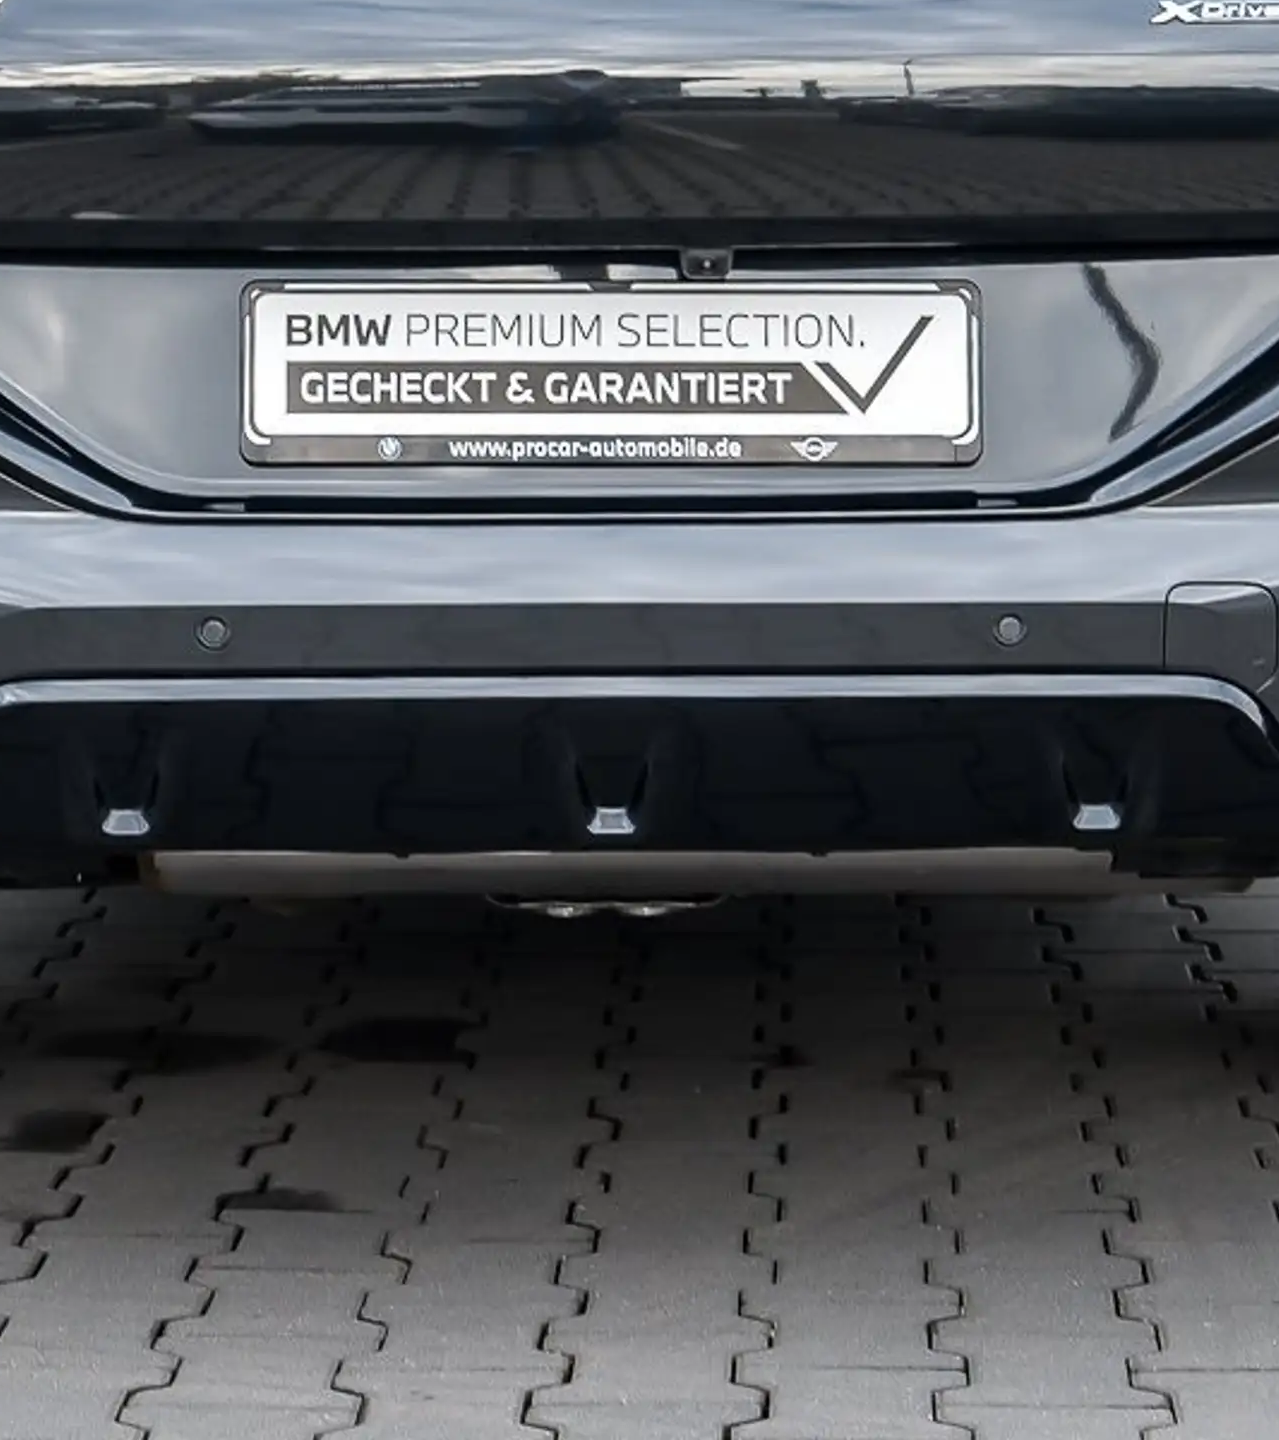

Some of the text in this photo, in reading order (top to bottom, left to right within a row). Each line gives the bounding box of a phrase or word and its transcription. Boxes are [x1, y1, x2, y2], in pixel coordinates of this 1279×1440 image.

[285, 312, 866, 348] BMW PREMIUM SELECTION.
[300, 371, 794, 404] GECHECKT & GARANTIERT
[448, 437, 742, 461] www.procar-automobile.de
